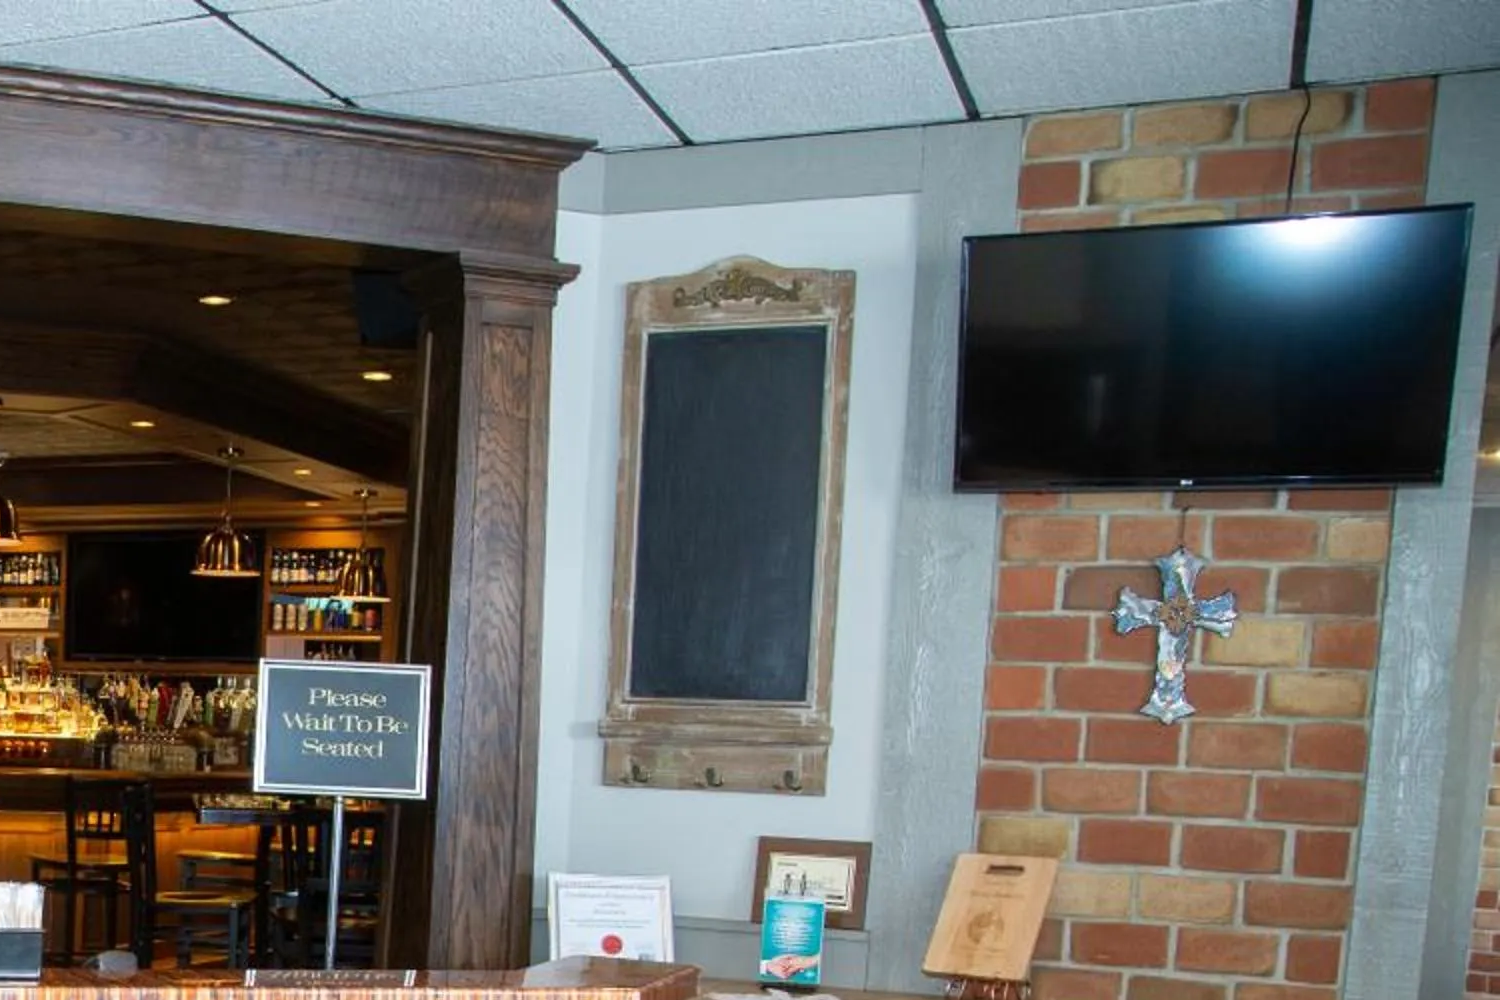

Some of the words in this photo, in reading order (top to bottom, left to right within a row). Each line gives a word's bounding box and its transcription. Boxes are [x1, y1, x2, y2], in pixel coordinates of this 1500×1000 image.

[308, 687, 388, 709] Please
[282, 711, 336, 732] Wait
[339, 714, 373, 734] To
[376, 715, 409, 735] Be
[301, 737, 384, 759] Seated
